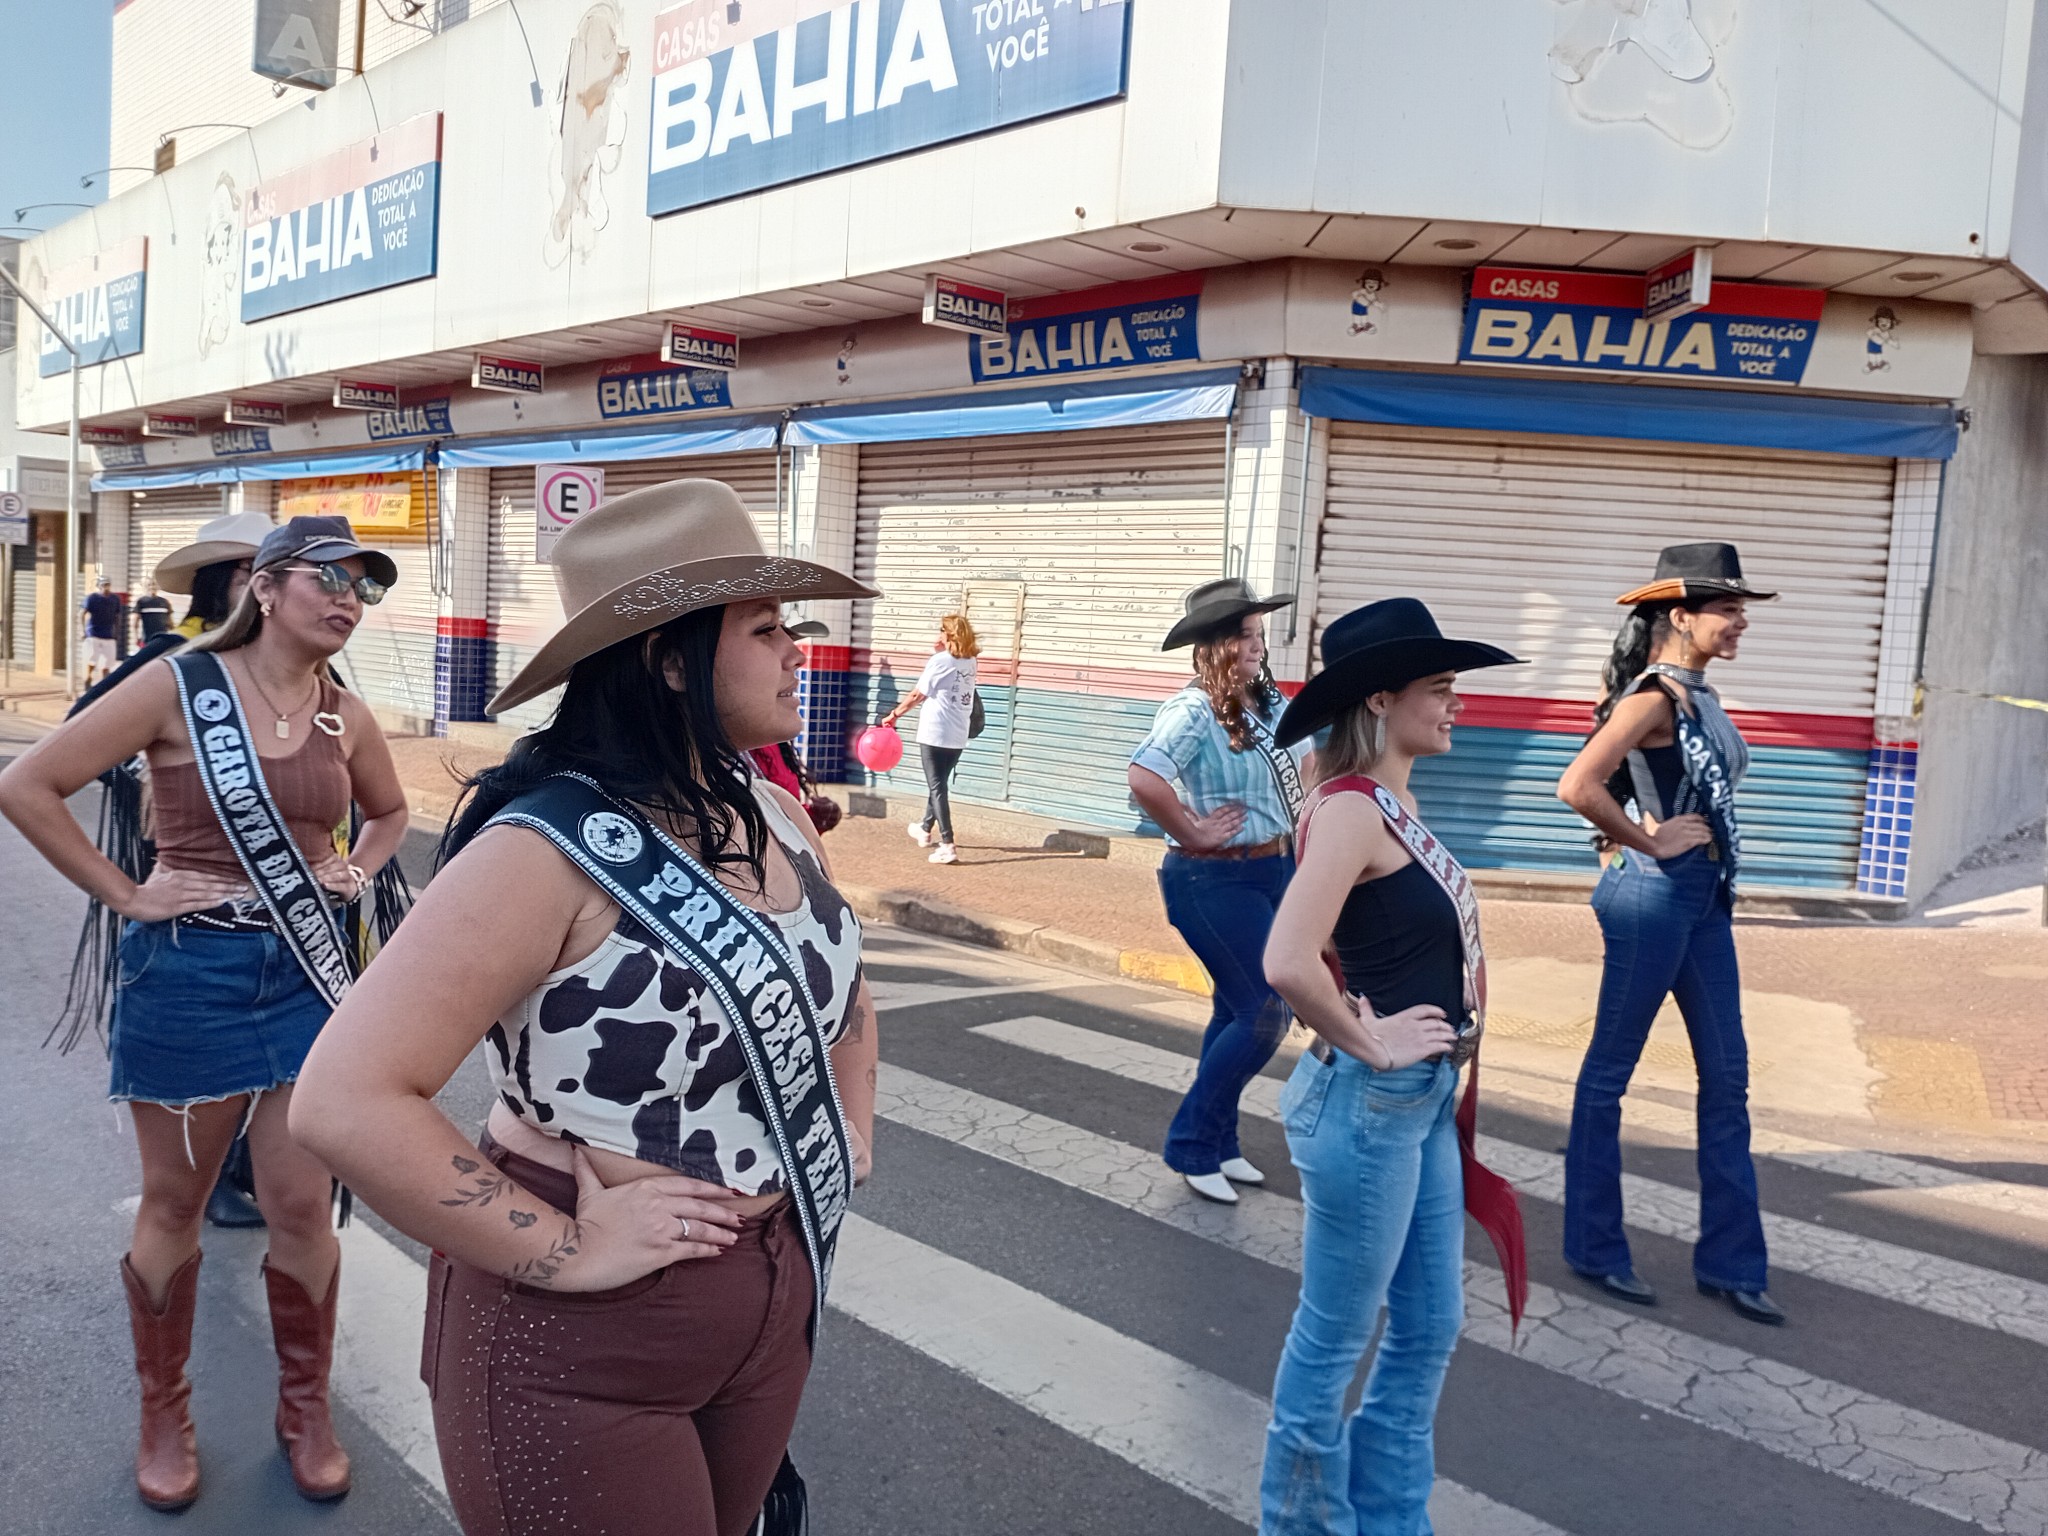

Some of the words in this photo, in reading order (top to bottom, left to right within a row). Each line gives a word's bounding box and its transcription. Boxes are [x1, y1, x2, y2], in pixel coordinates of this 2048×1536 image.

[972, 0, 1044, 35] TOTAL
[267, 13, 327, 71] A
[656, 10, 720, 69] CASAS
[986, 17, 1049, 72] VOCÊ
[651, 0, 959, 174] BAHIA
[371, 169, 424, 206] DEDICAÇÃO
[378, 207, 405, 228] TOTAL
[409, 205, 416, 218] A
[244, 187, 373, 294] BAHIA
[383, 222, 408, 251] VOCÊ
[1489, 278, 1560, 299] CASAS
[40, 284, 111, 356] BAHIA
[938, 293, 1003, 323] BAHIA
[1131, 304, 1186, 325] DEDICAÇÃO
[980, 317, 1134, 376] BAHIA
[1136, 328, 1167, 342] TOTAL
[1169, 325, 1178, 338] A
[1470, 308, 1717, 371] BAHIA
[1727, 322, 1807, 342] DEDICAÇÃO
[674, 336, 735, 360] BAHIA
[1731, 341, 1774, 357] TOTAL
[1777, 346, 1791, 359] A
[481, 364, 540, 386] BAHIA
[1739, 359, 1776, 375] VOCÊ
[341, 388, 396, 404] BAHIA
[601, 373, 695, 413] BAHIA
[369, 406, 430, 437] BAHIA
[5, 499, 14, 511] E
[561, 483, 579, 513] E
[203, 725, 280, 854] GAROTA
[256, 850, 305, 900] DA
[639, 861, 818, 1120] PRINCESA
